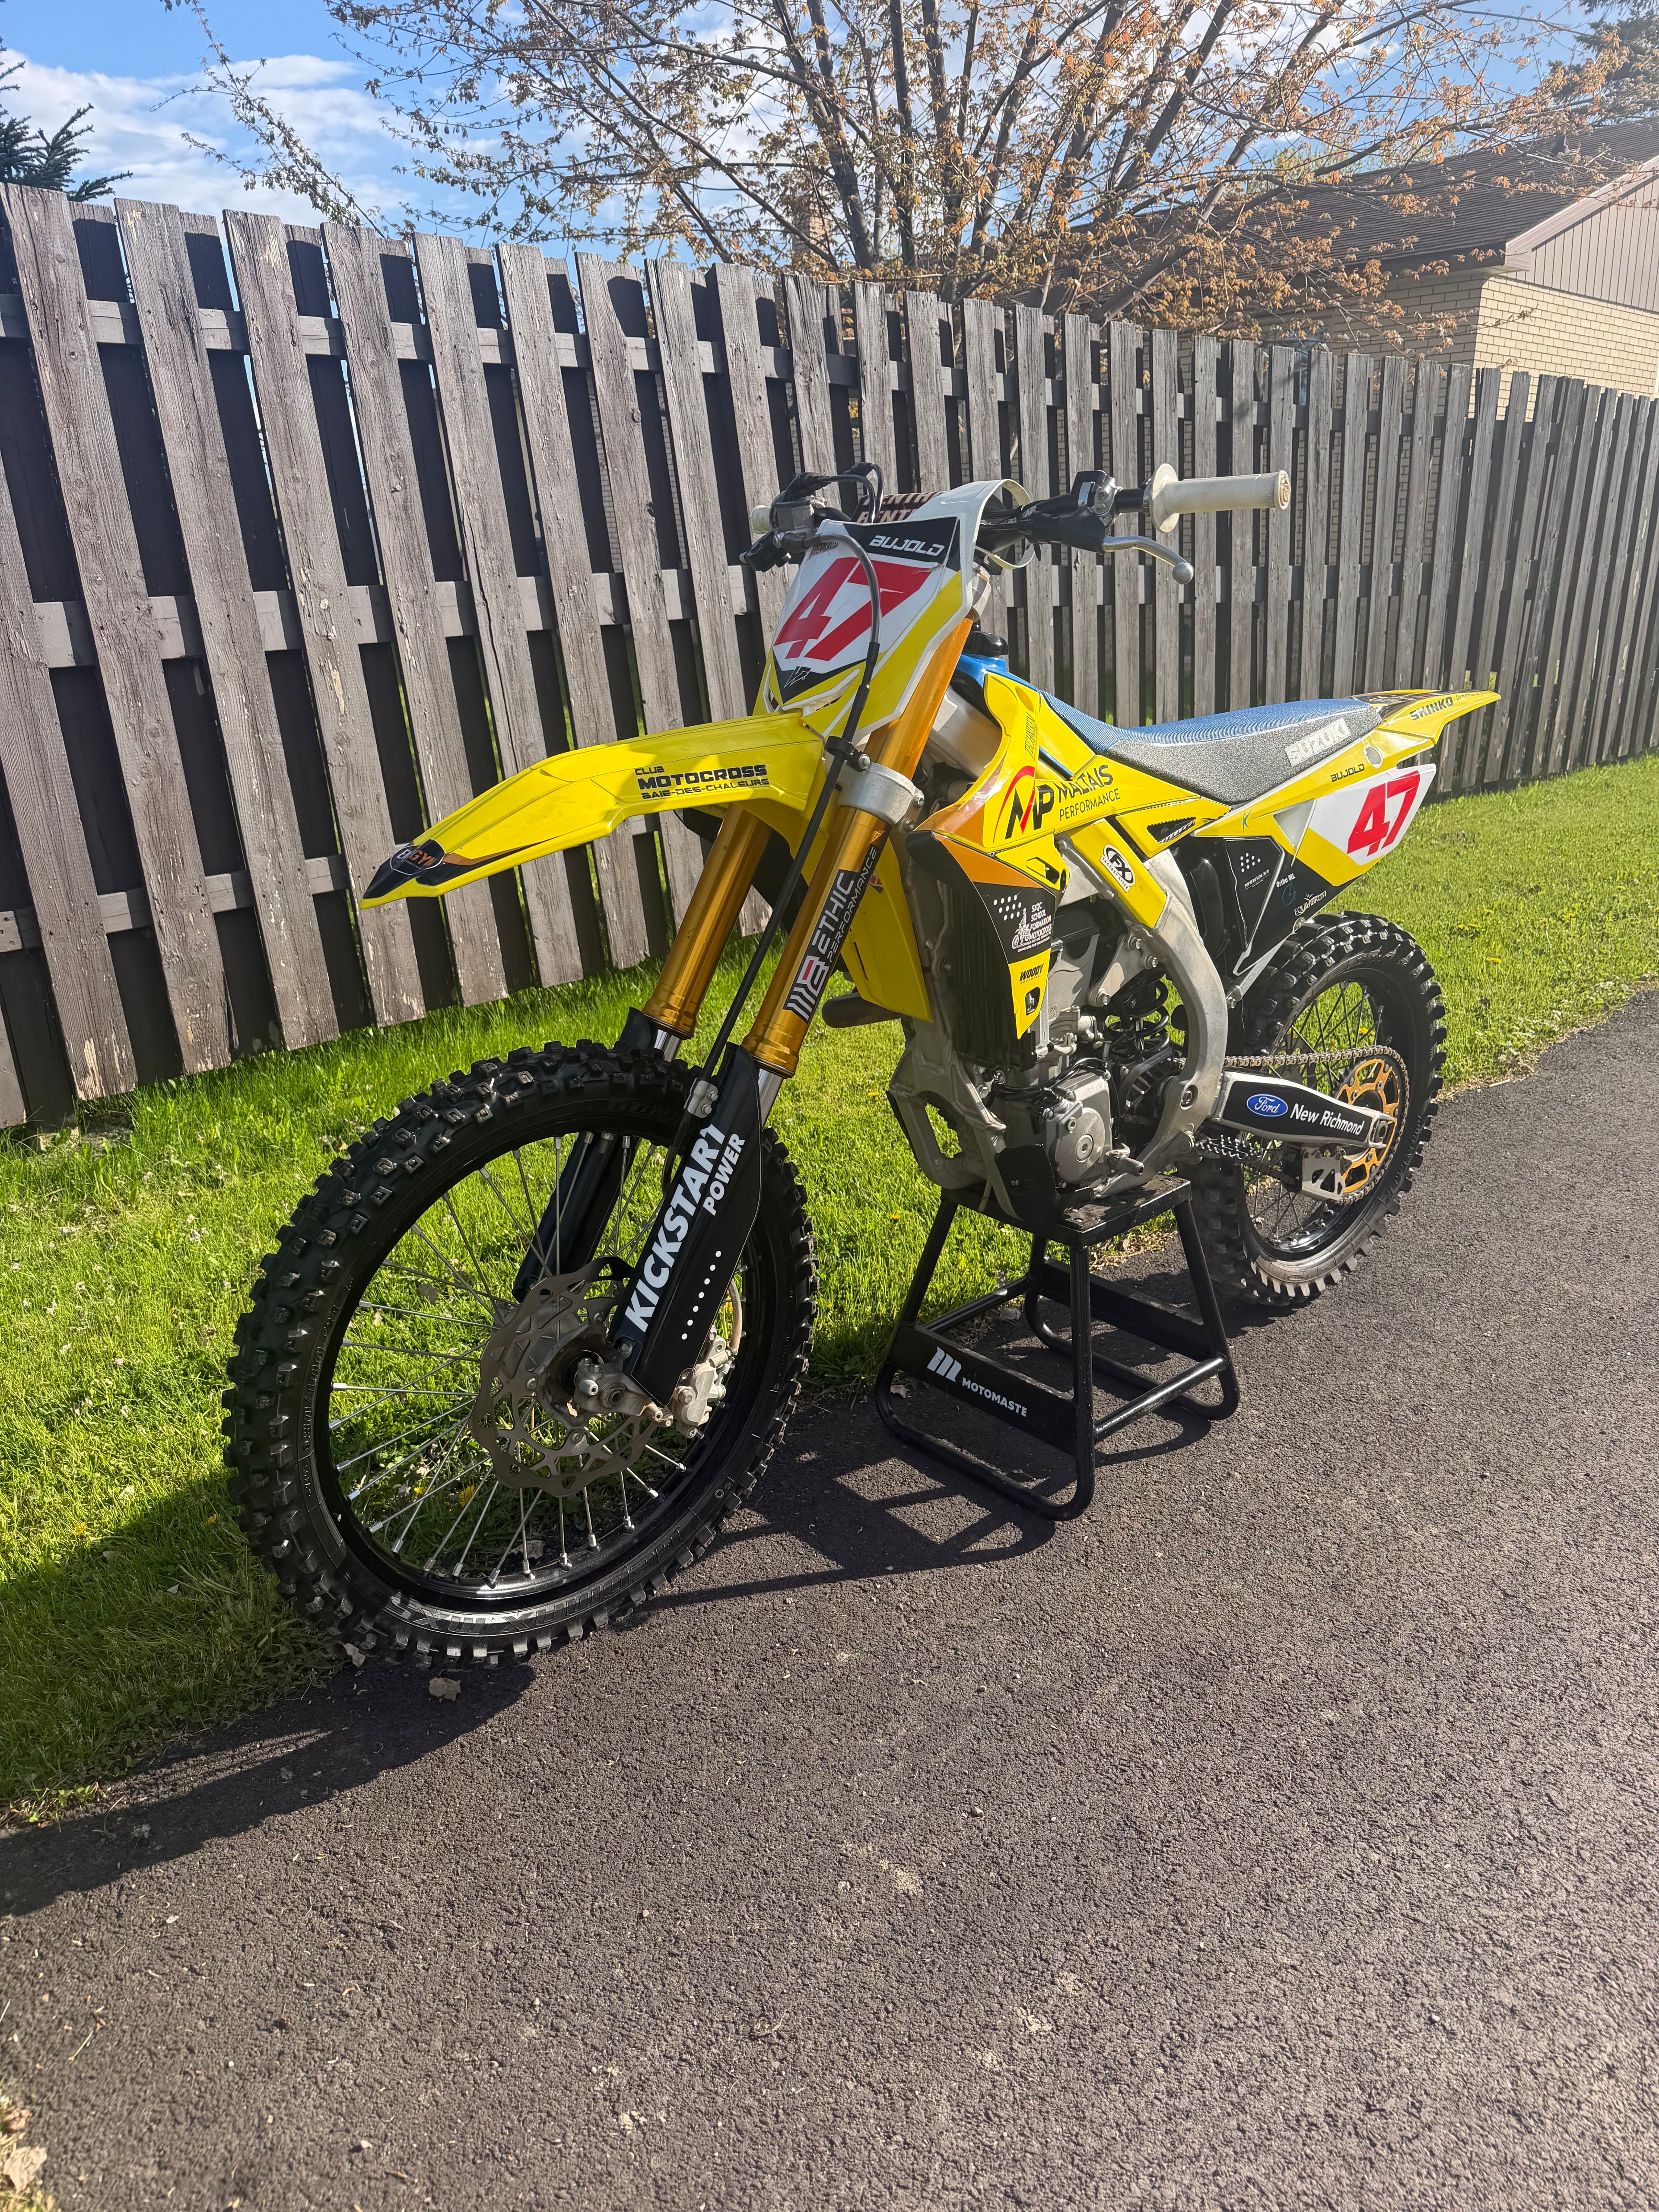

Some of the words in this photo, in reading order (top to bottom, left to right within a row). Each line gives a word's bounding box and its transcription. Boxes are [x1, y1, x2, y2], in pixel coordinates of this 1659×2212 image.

[869, 535, 946, 557] BUJOLD
[773, 558, 934, 661] 47
[1287, 718, 1351, 764] SUZUKI
[635, 766, 664, 775] CLUB
[637, 764, 767, 790] MOTOCROSS
[1330, 763, 1365, 782] BUJOLD
[642, 779, 770, 799] BAIE-DES-CHALEURS
[1058, 764, 1113, 804] MALTAIS
[1060, 788, 1121, 821] PERFORMANCE
[1347, 771, 1420, 855] 47
[1109, 853, 1132, 880] FX
[811, 872, 855, 955] ETHIC
[828, 847, 877, 963] PERFORMANCE
[1030, 909, 1047, 922] SCHOOL
[1029, 924, 1052, 941] MOTOCROSS
[1030, 915, 1052, 931] FORMATION
[1019, 963, 1044, 982] WOODY
[1254, 1096, 1281, 1113] Ford
[1290, 1103, 1319, 1123] New
[1320, 1110, 1364, 1135] Richmond
[702, 1133, 746, 1216] POWER
